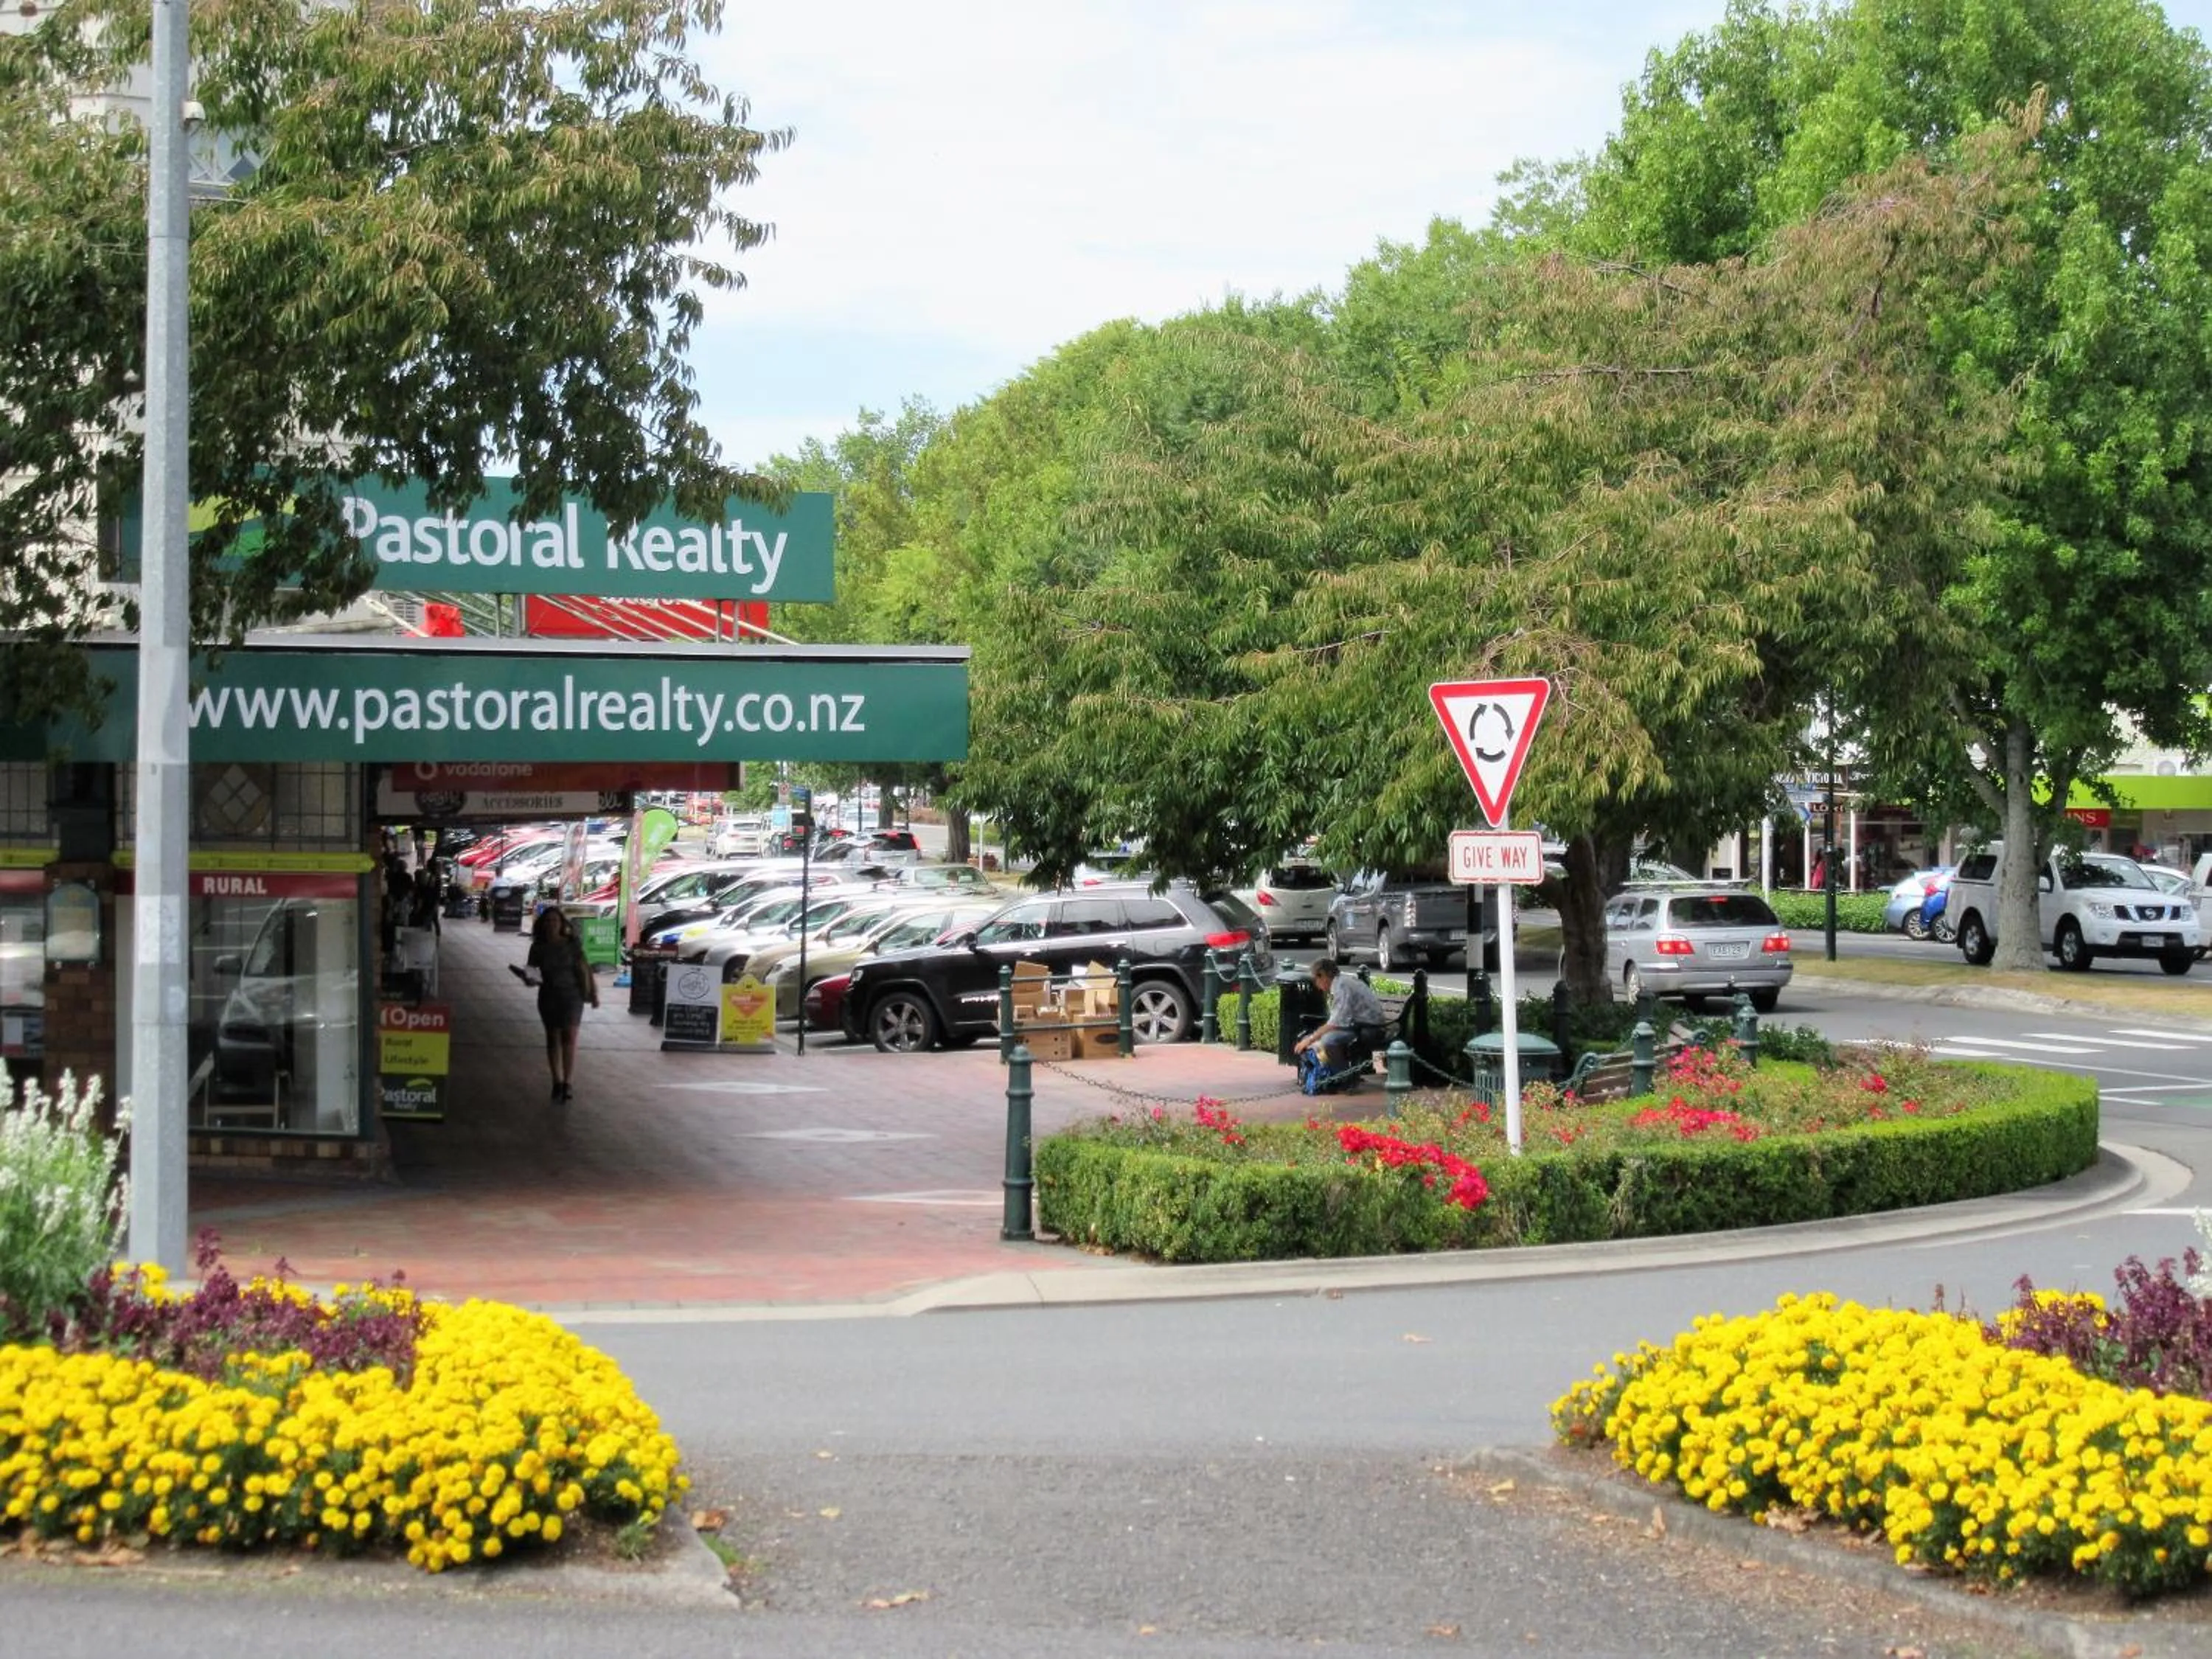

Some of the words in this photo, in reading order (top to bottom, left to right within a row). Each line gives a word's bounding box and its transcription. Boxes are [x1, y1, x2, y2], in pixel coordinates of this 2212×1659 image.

[342, 495, 584, 568] Pastoral
[188, 675, 865, 747] www.pastoralrealty.co.nz
[1464, 846, 1492, 868] GIVE
[1500, 846, 1528, 869] WAY
[204, 877, 268, 894] RURAL
[390, 1006, 445, 1029] Open
